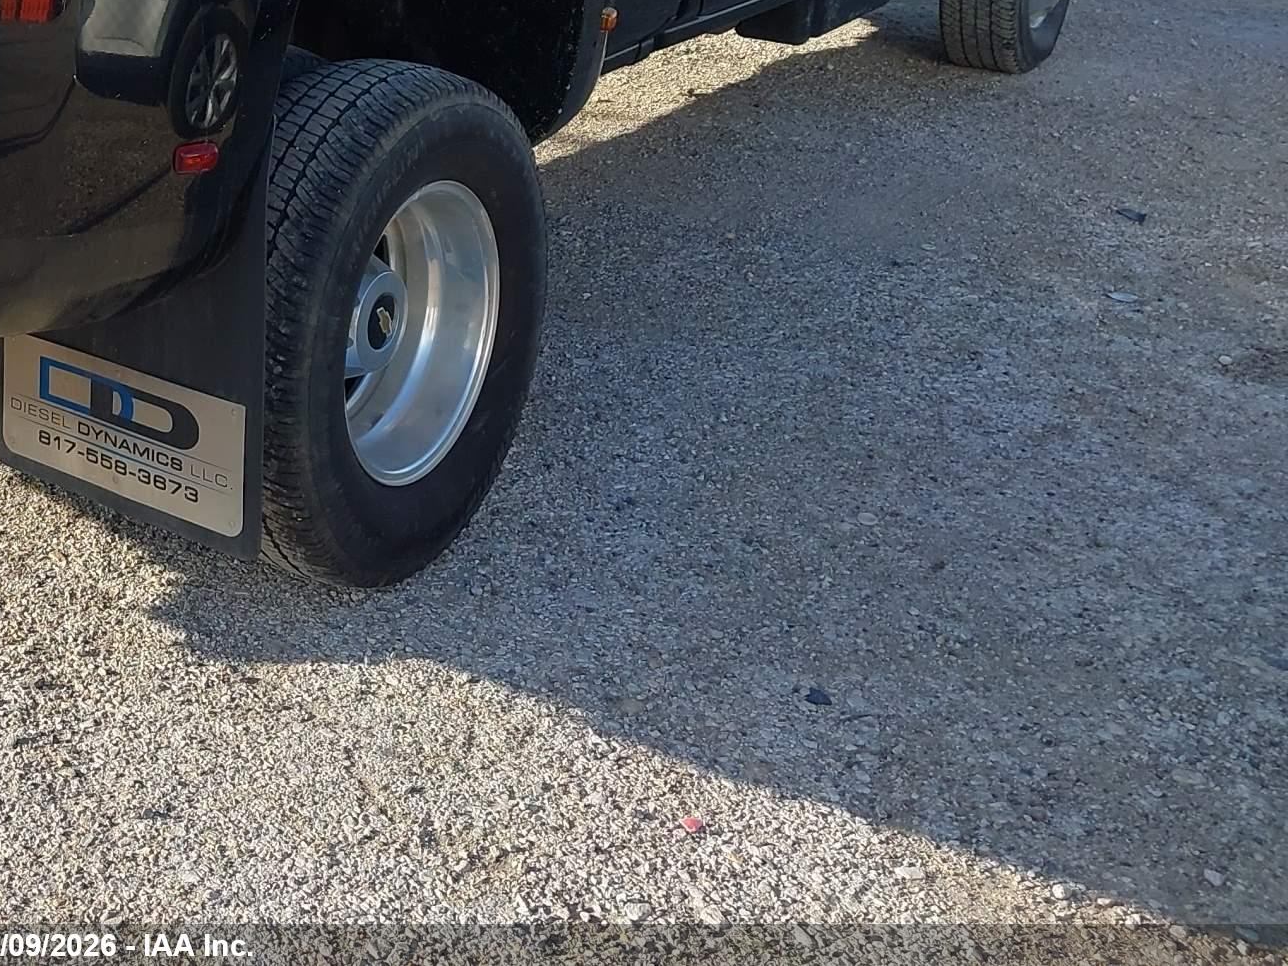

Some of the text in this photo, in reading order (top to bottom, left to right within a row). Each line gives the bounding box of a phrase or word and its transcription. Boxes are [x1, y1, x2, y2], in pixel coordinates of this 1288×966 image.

[10, 397, 234, 490] DIESEL DYNAMICS LLC.
[38, 430, 199, 503] 817-558-3673
